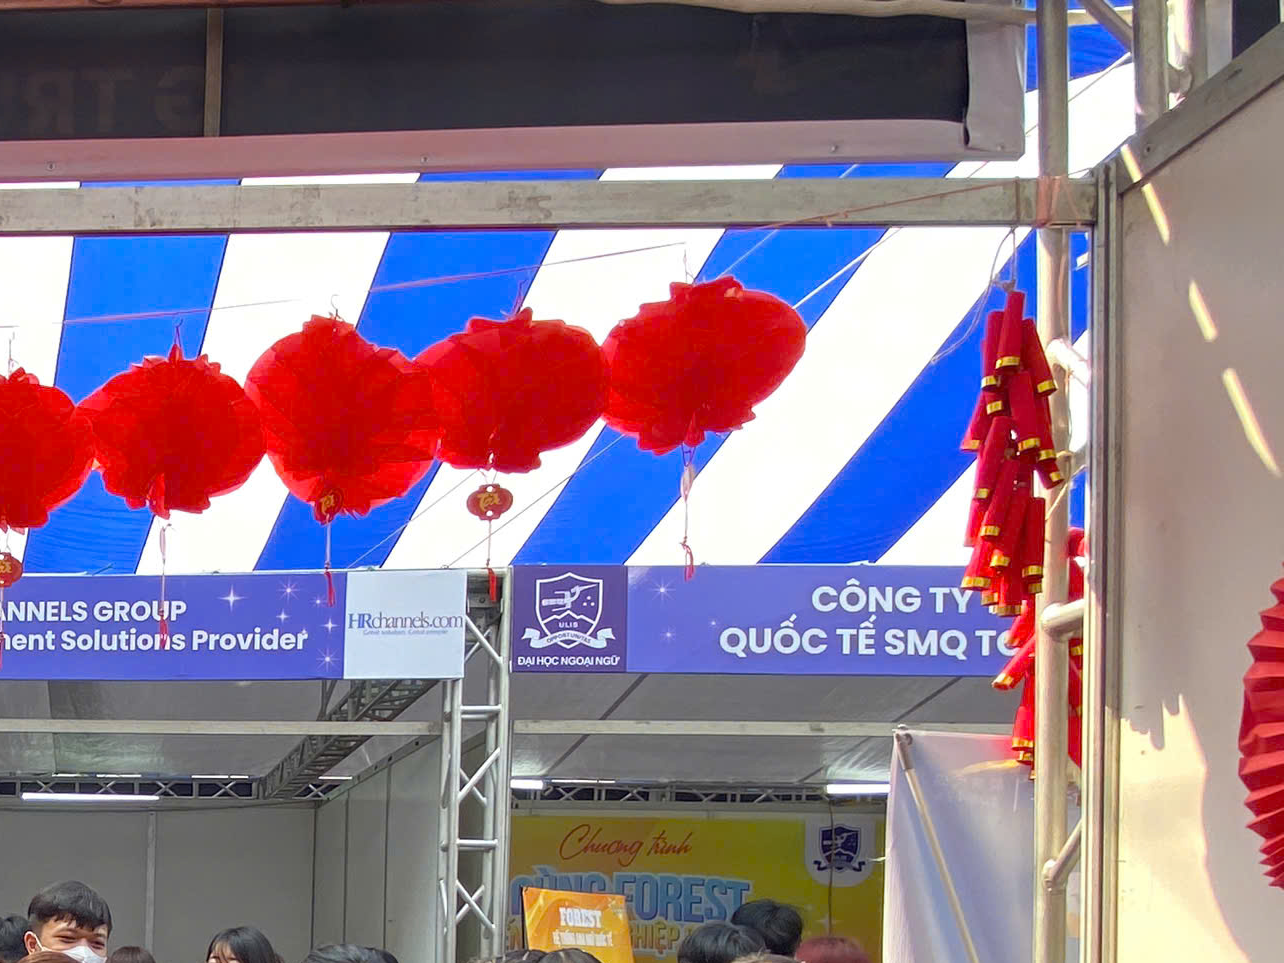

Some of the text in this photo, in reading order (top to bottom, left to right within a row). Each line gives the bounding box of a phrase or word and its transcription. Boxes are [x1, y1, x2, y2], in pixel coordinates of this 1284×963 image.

[812, 578, 974, 613] CÔNG TY
[93, 601, 187, 622] GROUP
[348, 611, 463, 629] HRchannels.com
[60, 629, 186, 651] Solutions
[192, 629, 309, 651] Provider
[719, 614, 828, 658] QUỐC
[836, 615, 877, 656] TẾ
[884, 629, 968, 661] SMQ
[517, 654, 620, 668] ĐẠI HỌC NGOẠI NGỮ
[618, 874, 750, 922] FOREST
